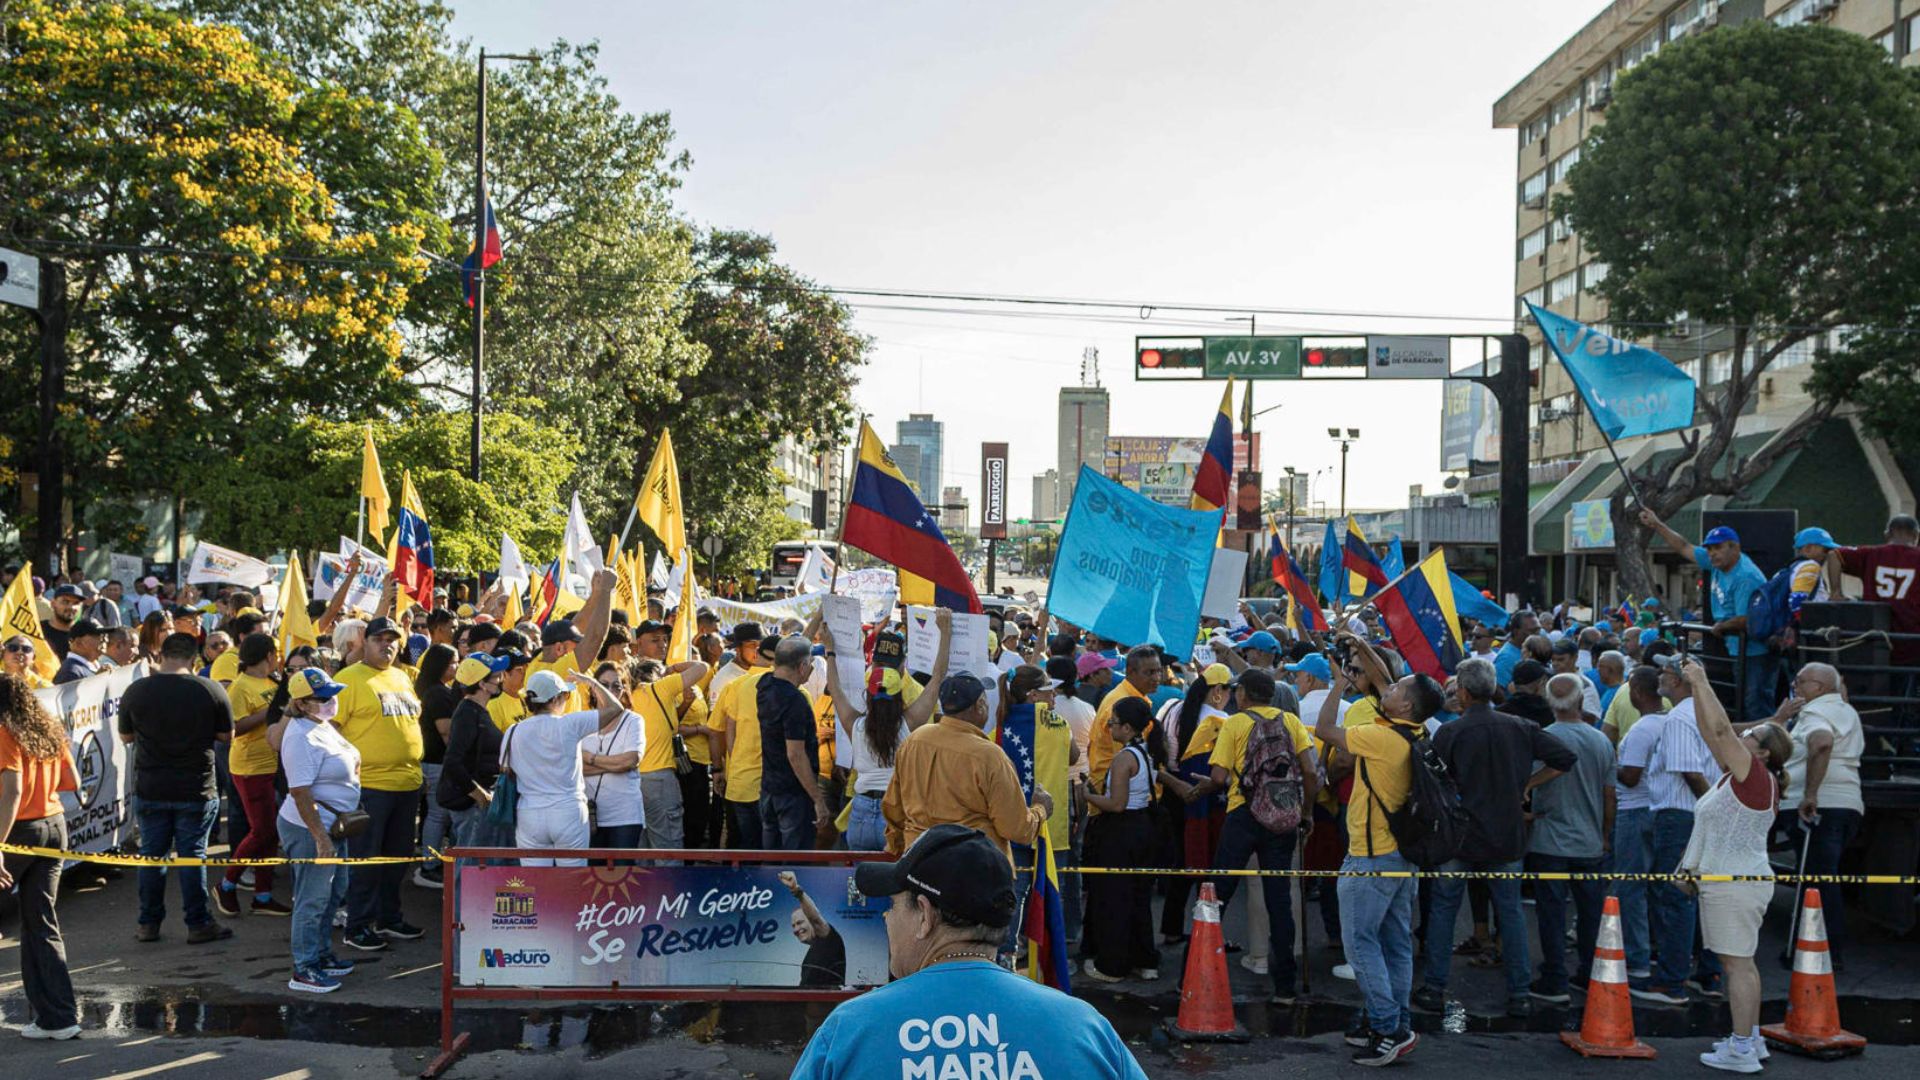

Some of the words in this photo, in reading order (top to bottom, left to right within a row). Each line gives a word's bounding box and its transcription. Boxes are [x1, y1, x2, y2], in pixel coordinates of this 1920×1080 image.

[1225, 351, 1255, 365] AV.
[1259, 351, 1280, 365] 3Y
[991, 461, 1001, 520] PARRUGGIO
[1875, 566, 1915, 599] 57
[575, 901, 646, 931] #Con
[656, 892, 691, 920] Mi
[699, 886, 773, 919] Gente
[479, 948, 550, 967] Maduro
[580, 930, 626, 965] Se
[636, 912, 779, 959] Resuelve
[899, 1013, 999, 1051] CON
[901, 1042, 1044, 1080] MARÍA
